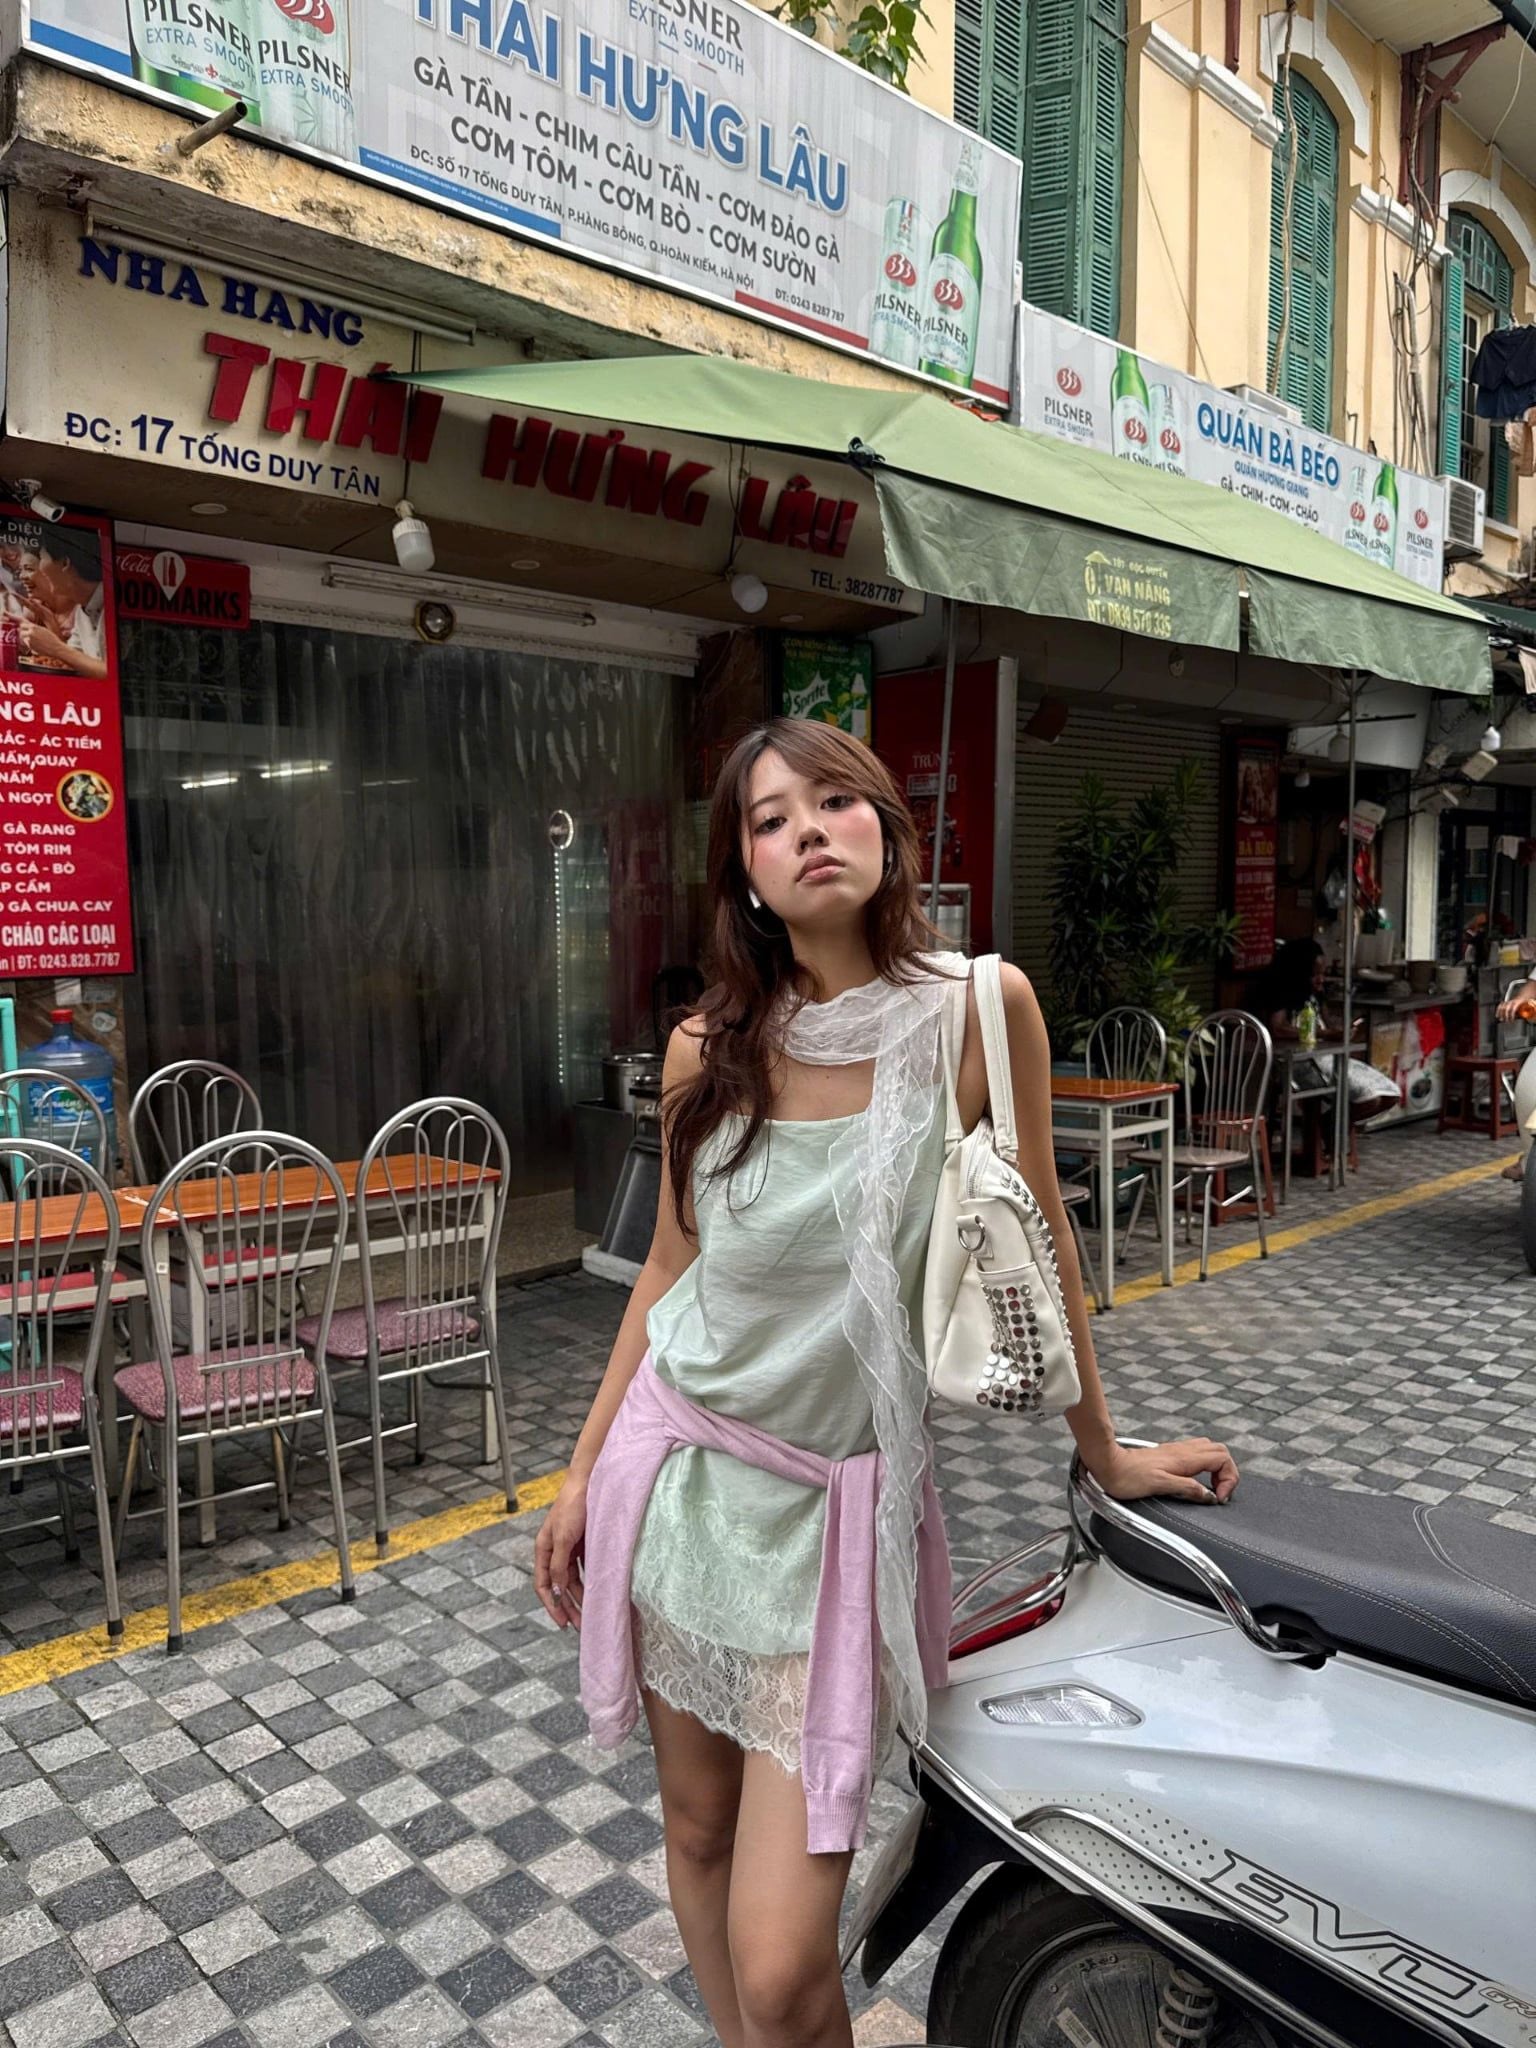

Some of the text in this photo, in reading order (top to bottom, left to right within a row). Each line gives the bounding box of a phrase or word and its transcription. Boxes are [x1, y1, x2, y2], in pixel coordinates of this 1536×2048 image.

[146, 28, 197, 48] EXTRA
[629, 0, 744, 76] EXTRA SMOOTH
[258, 40, 352, 99] PILSNER
[261, 69, 306, 88] EXTRA
[579, 32, 745, 165] HƯNG
[414, 57, 454, 97] GÀ
[535, 111, 598, 159] CHIM
[606, 142, 652, 180] CÂU
[719, 192, 766, 231] CƠM
[771, 214, 810, 249] ĐẢO
[816, 234, 840, 263] GÀ
[451, 116, 514, 164] CƠM
[522, 145, 577, 189] TÔM
[599, 179, 653, 221] CƠM
[661, 202, 691, 234] BÒ
[710, 225, 756, 262] CƠM
[763, 247, 816, 285] SƯỜN
[410, 145, 434, 166] ĐC:
[437, 155, 455, 173] SỐ
[458, 165, 470, 178] 17
[473, 170, 508, 194] TỐNG
[512, 186, 536, 205] DUY
[568, 208, 609, 235] P.HÀNG
[649, 240, 690, 265] Q.HOÀN
[720, 266, 734, 282] HÀ
[736, 273, 754, 290] NỘI
[775, 287, 789, 303] ĐT:
[874, 293, 921, 329] PILSNER
[923, 316, 968, 351] PILSNER
[1044, 396, 1093, 427] PILSNER
[65, 411, 380, 498] ĐC: 17 TỐNG DUY TÂN
[1197, 403, 1340, 487] QUÁN BÀ BÉO
[481, 413, 716, 527] HƯNG
[1240, 484, 1264, 503] CHIM
[811, 569, 905, 605] TEL: 38287787
[43, 701, 101, 727] LÂU
[9, 791, 54, 806] NGỌT
[3, 820, 76, 836] GÀ RANG
[4, 841, 72, 855] TÔM RIM
[8, 899, 113, 913] GÀ CHUA CAY
[2, 921, 116, 949] CHÁO CÁC LOẠI
[17, 955, 38, 970] ĐT:
[39, 952, 120, 969] 0243.828.7787
